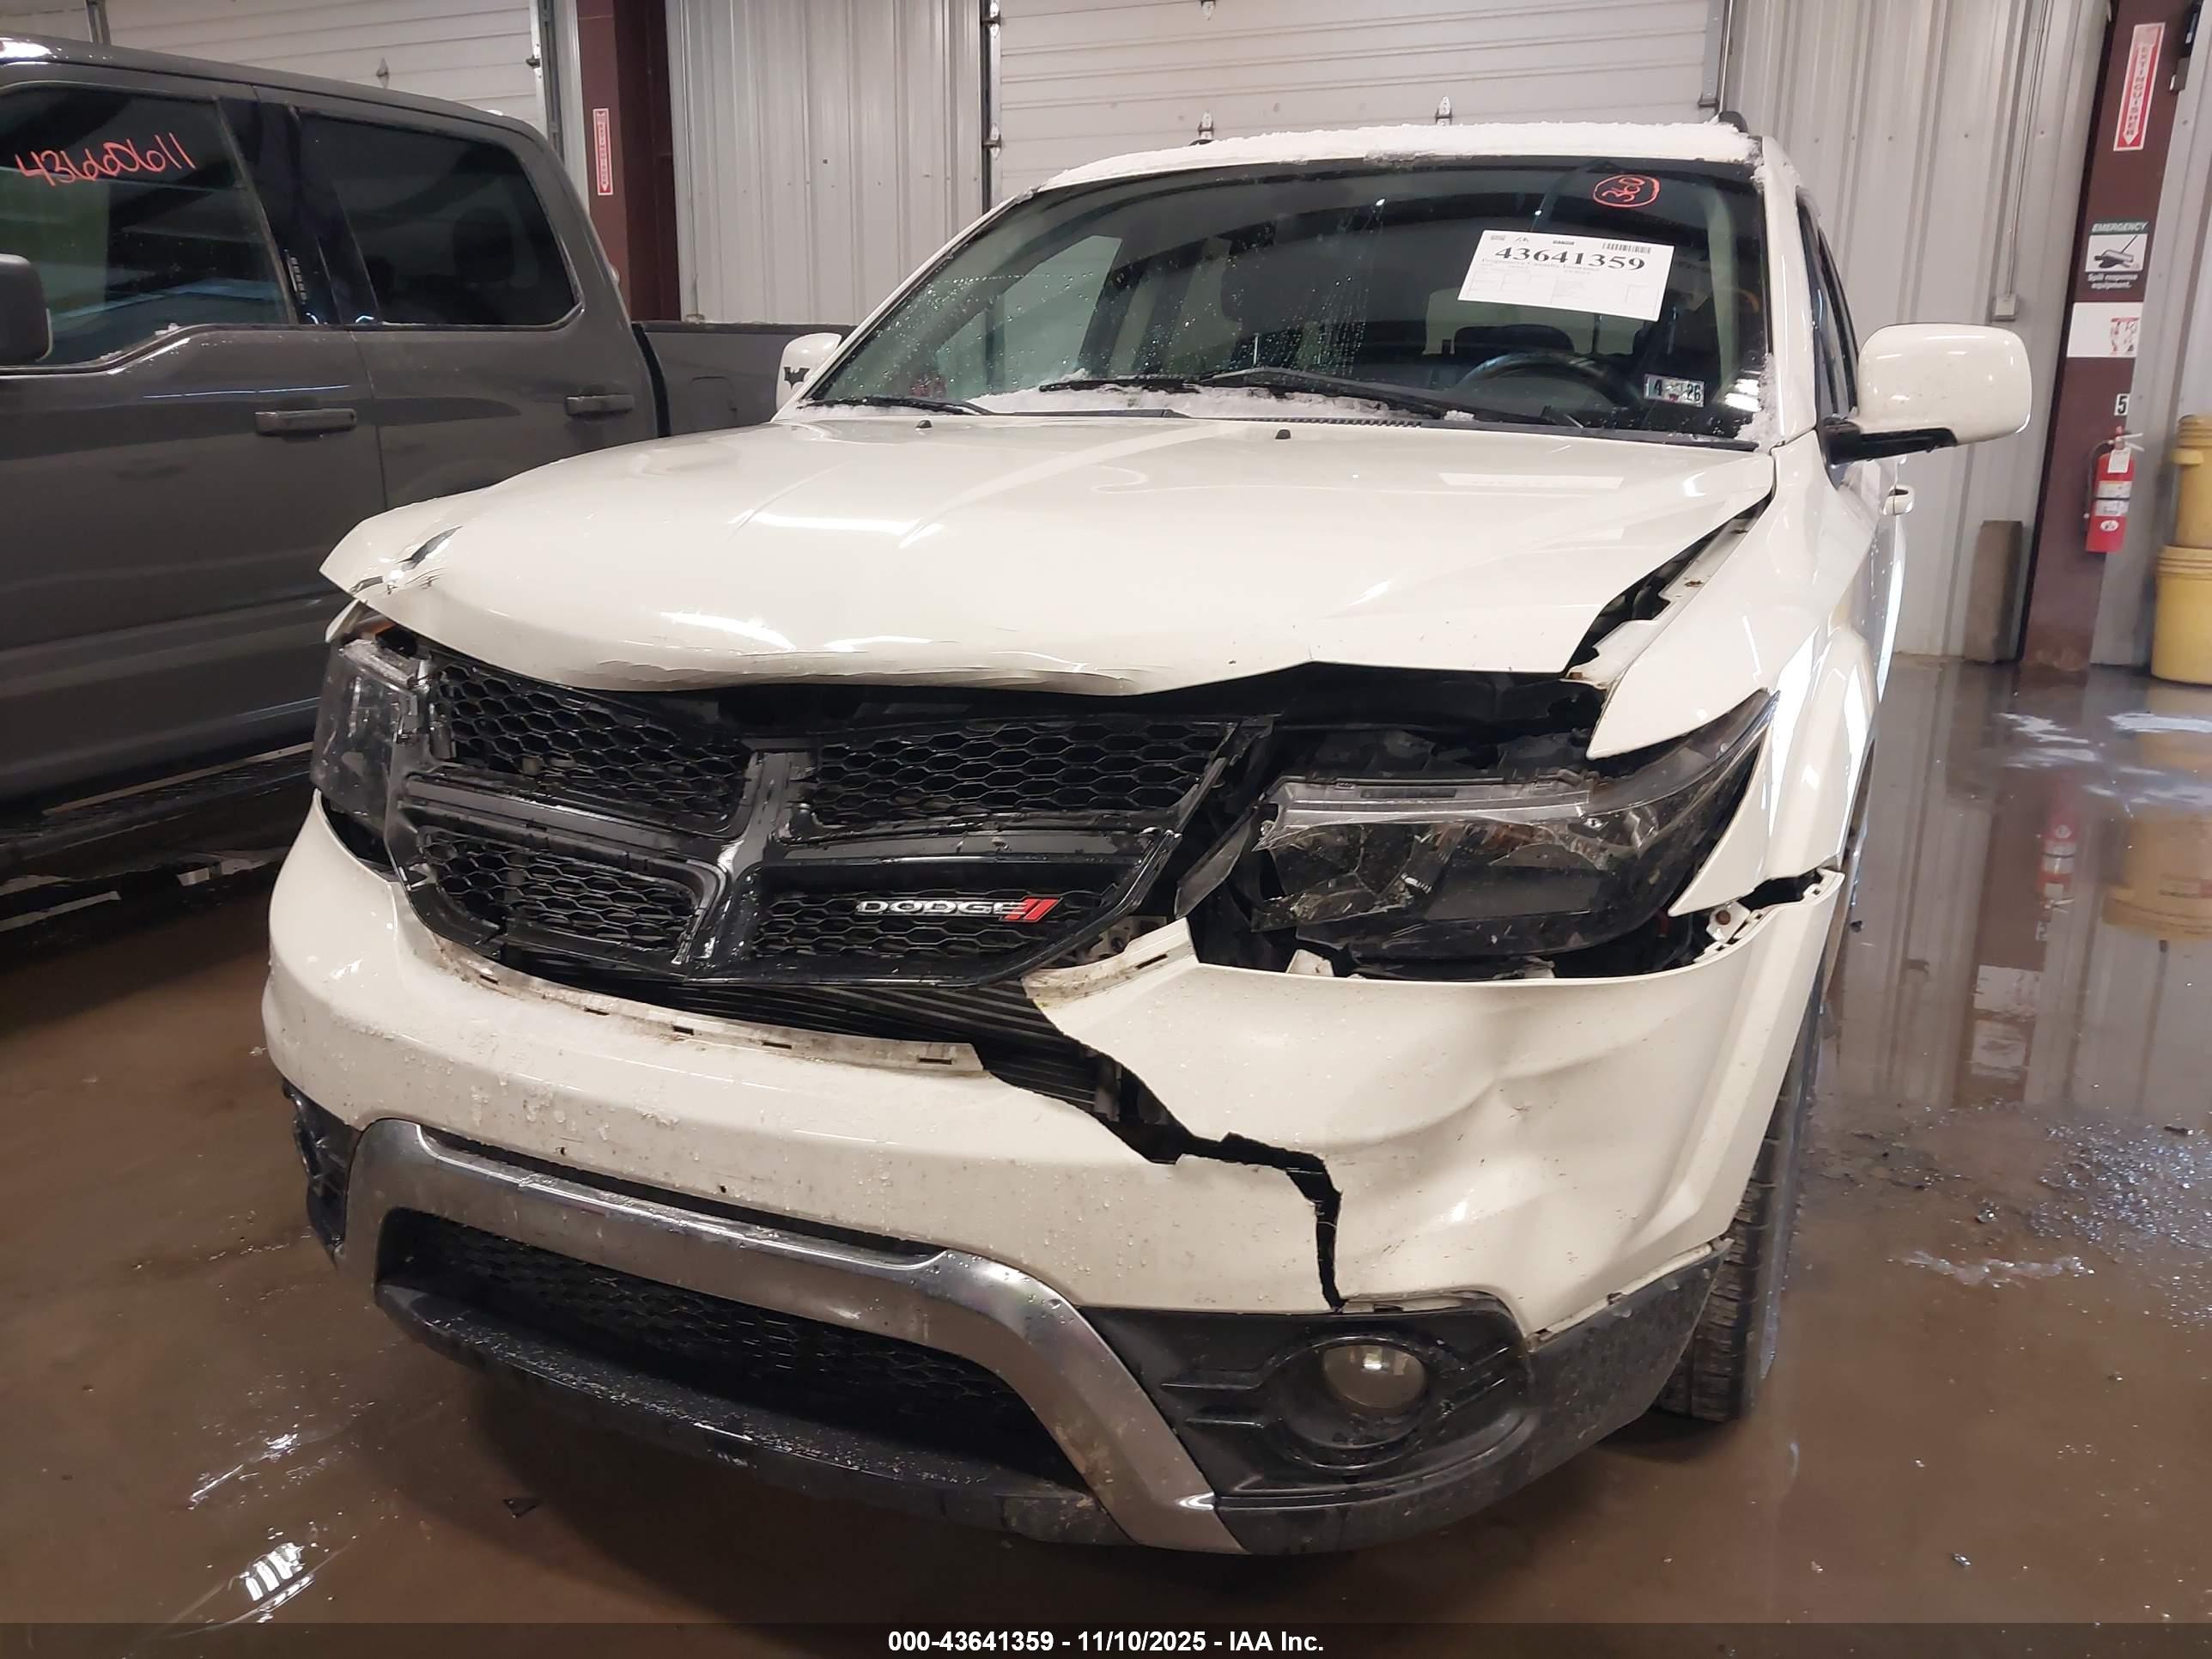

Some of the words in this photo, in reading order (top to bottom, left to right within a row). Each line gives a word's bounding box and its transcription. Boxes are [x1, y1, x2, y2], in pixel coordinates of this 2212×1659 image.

[2092, 222, 2148, 232] EMERGENCY
[1495, 246, 1645, 270] 43641359
[1654, 380, 1662, 396] 4
[1686, 383, 1701, 402] 26
[2118, 396, 2128, 414] 5
[857, 899, 1027, 915] DODGE
